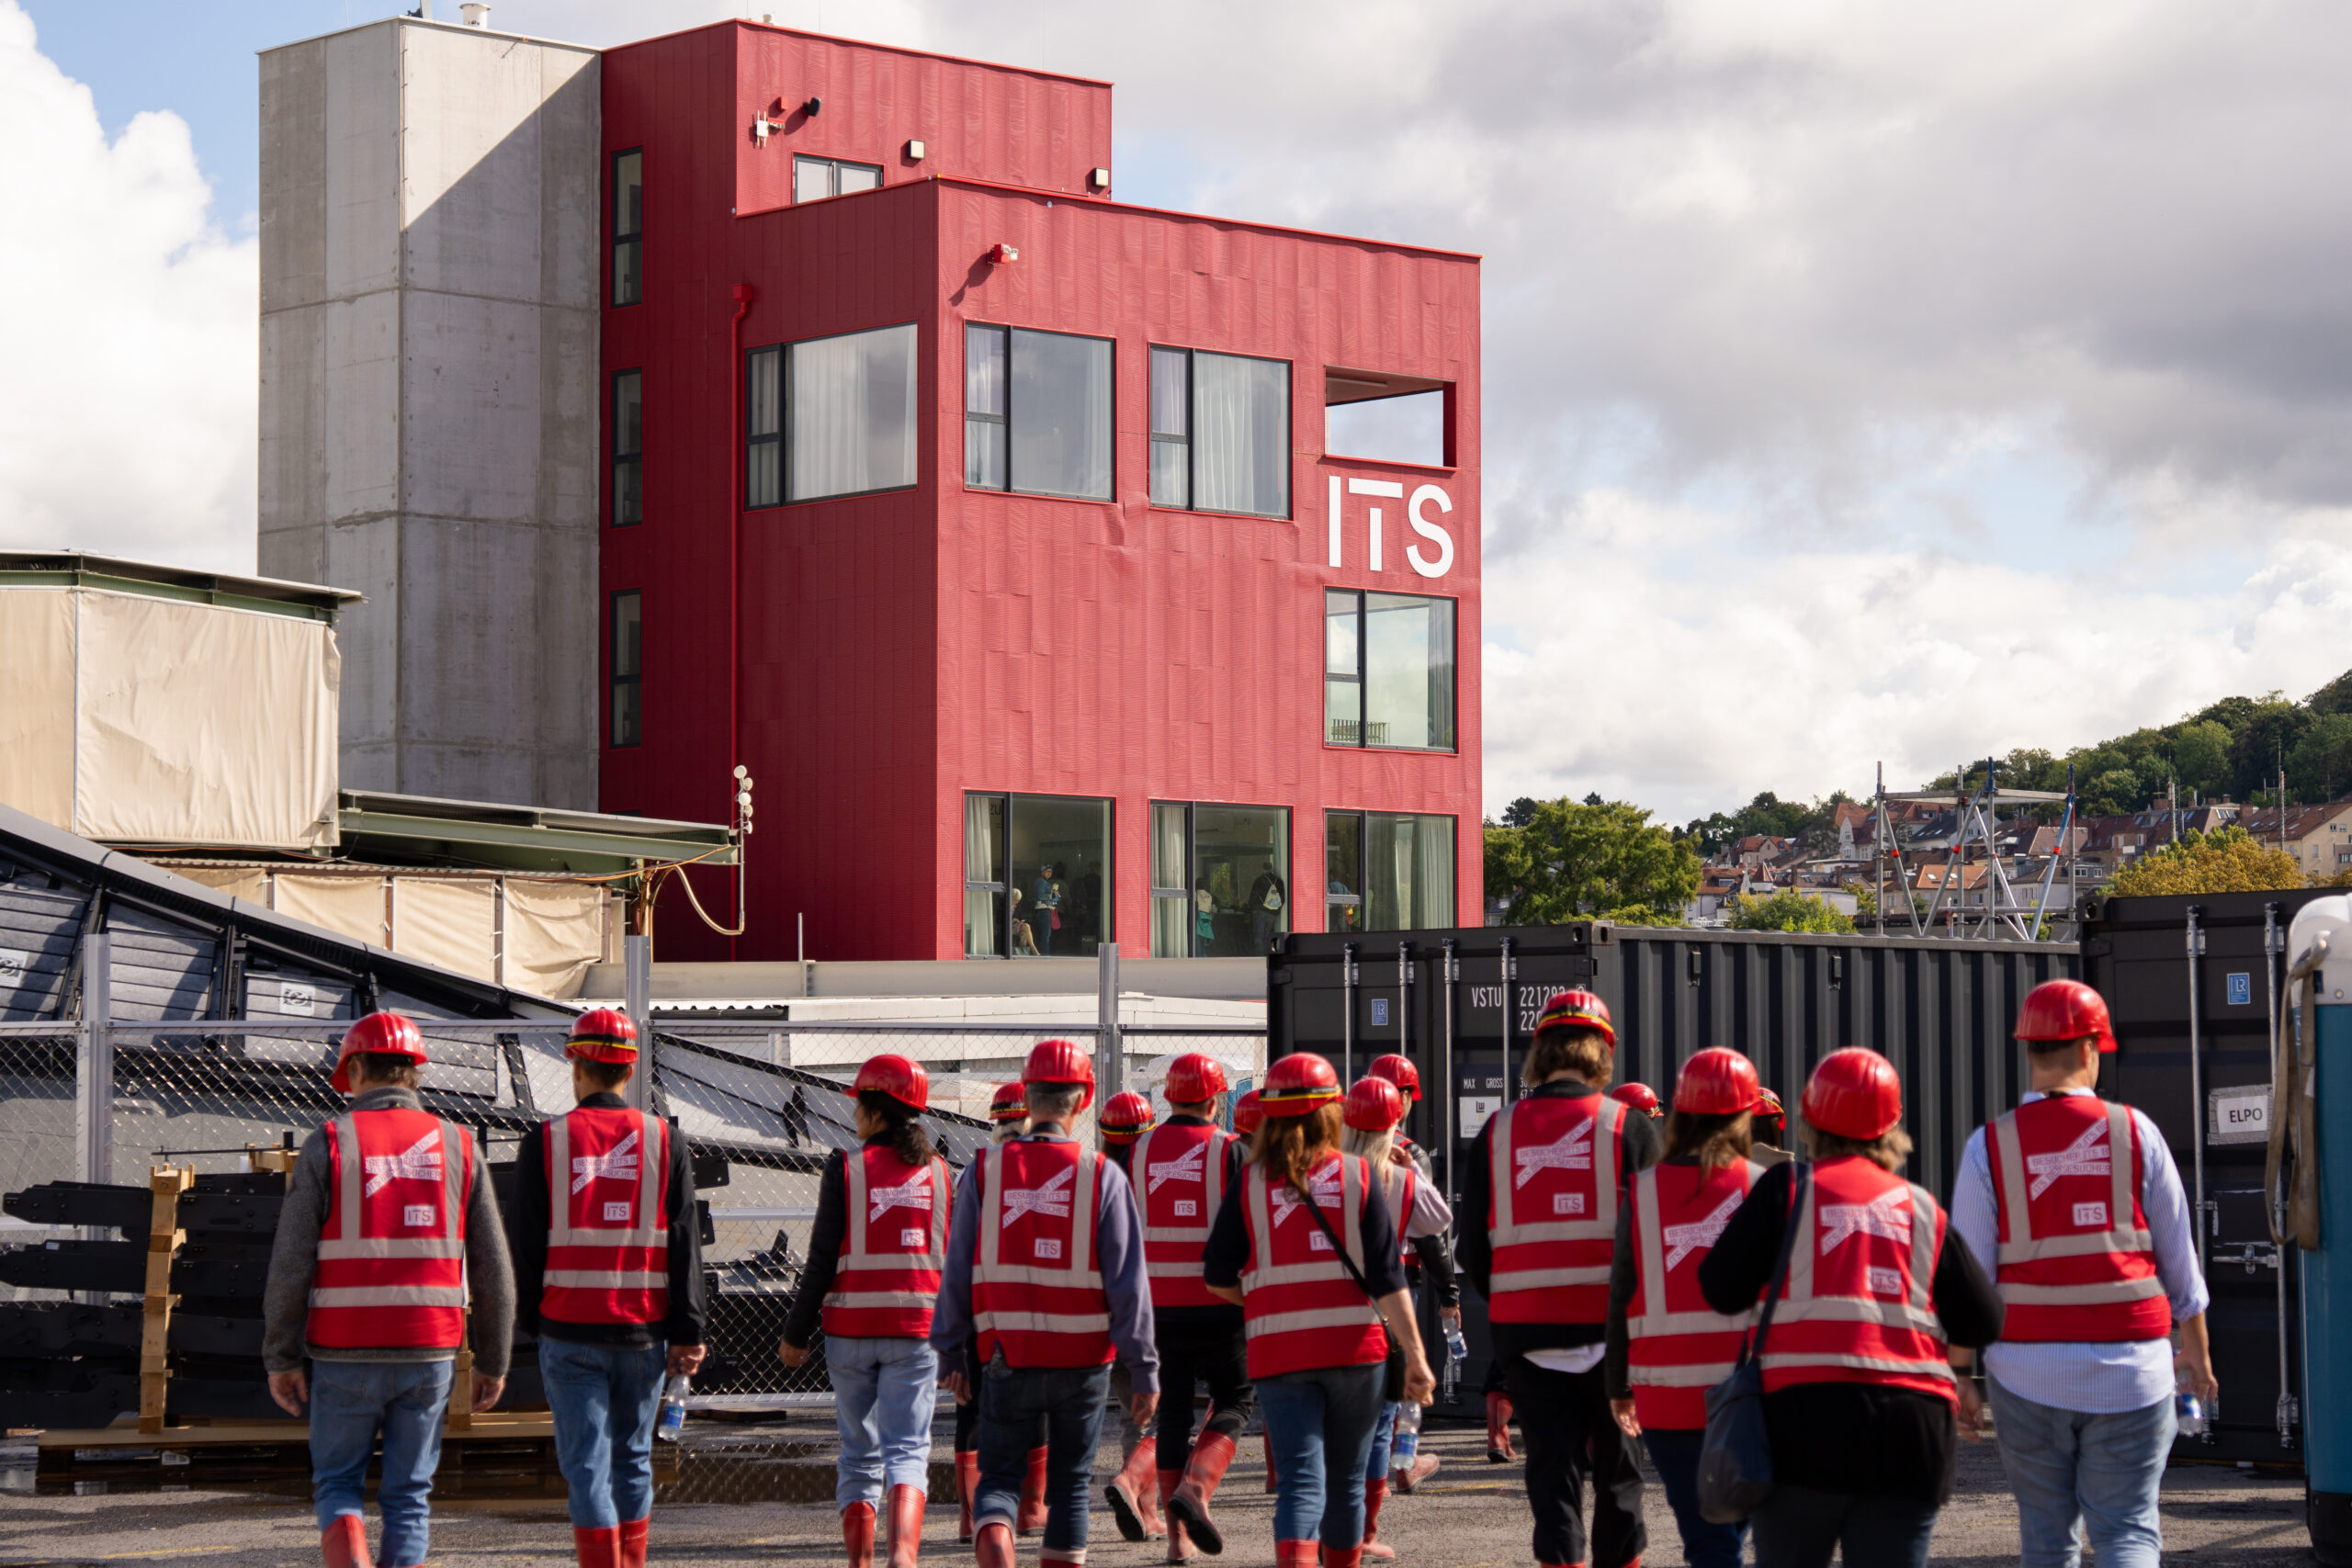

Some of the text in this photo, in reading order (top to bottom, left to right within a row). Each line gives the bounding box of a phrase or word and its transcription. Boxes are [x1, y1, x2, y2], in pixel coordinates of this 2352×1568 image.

[1329, 475, 1454, 579] ITS
[1472, 987, 1502, 1007] VSTU
[1464, 1078, 1476, 1089] MAX
[1486, 1077, 1503, 1089] GROSS
[2230, 1108, 2262, 1122] ELPO
[606, 1205, 627, 1217] ITS
[1177, 1203, 1193, 1213] ITS
[1558, 1198, 1580, 1211] ITS
[408, 1209, 431, 1223] ITS
[2078, 1207, 2103, 1222] ITS
[904, 1233, 921, 1243] ITS
[1038, 1242, 1057, 1255] ITS
[1871, 1272, 1897, 1290] ITS
